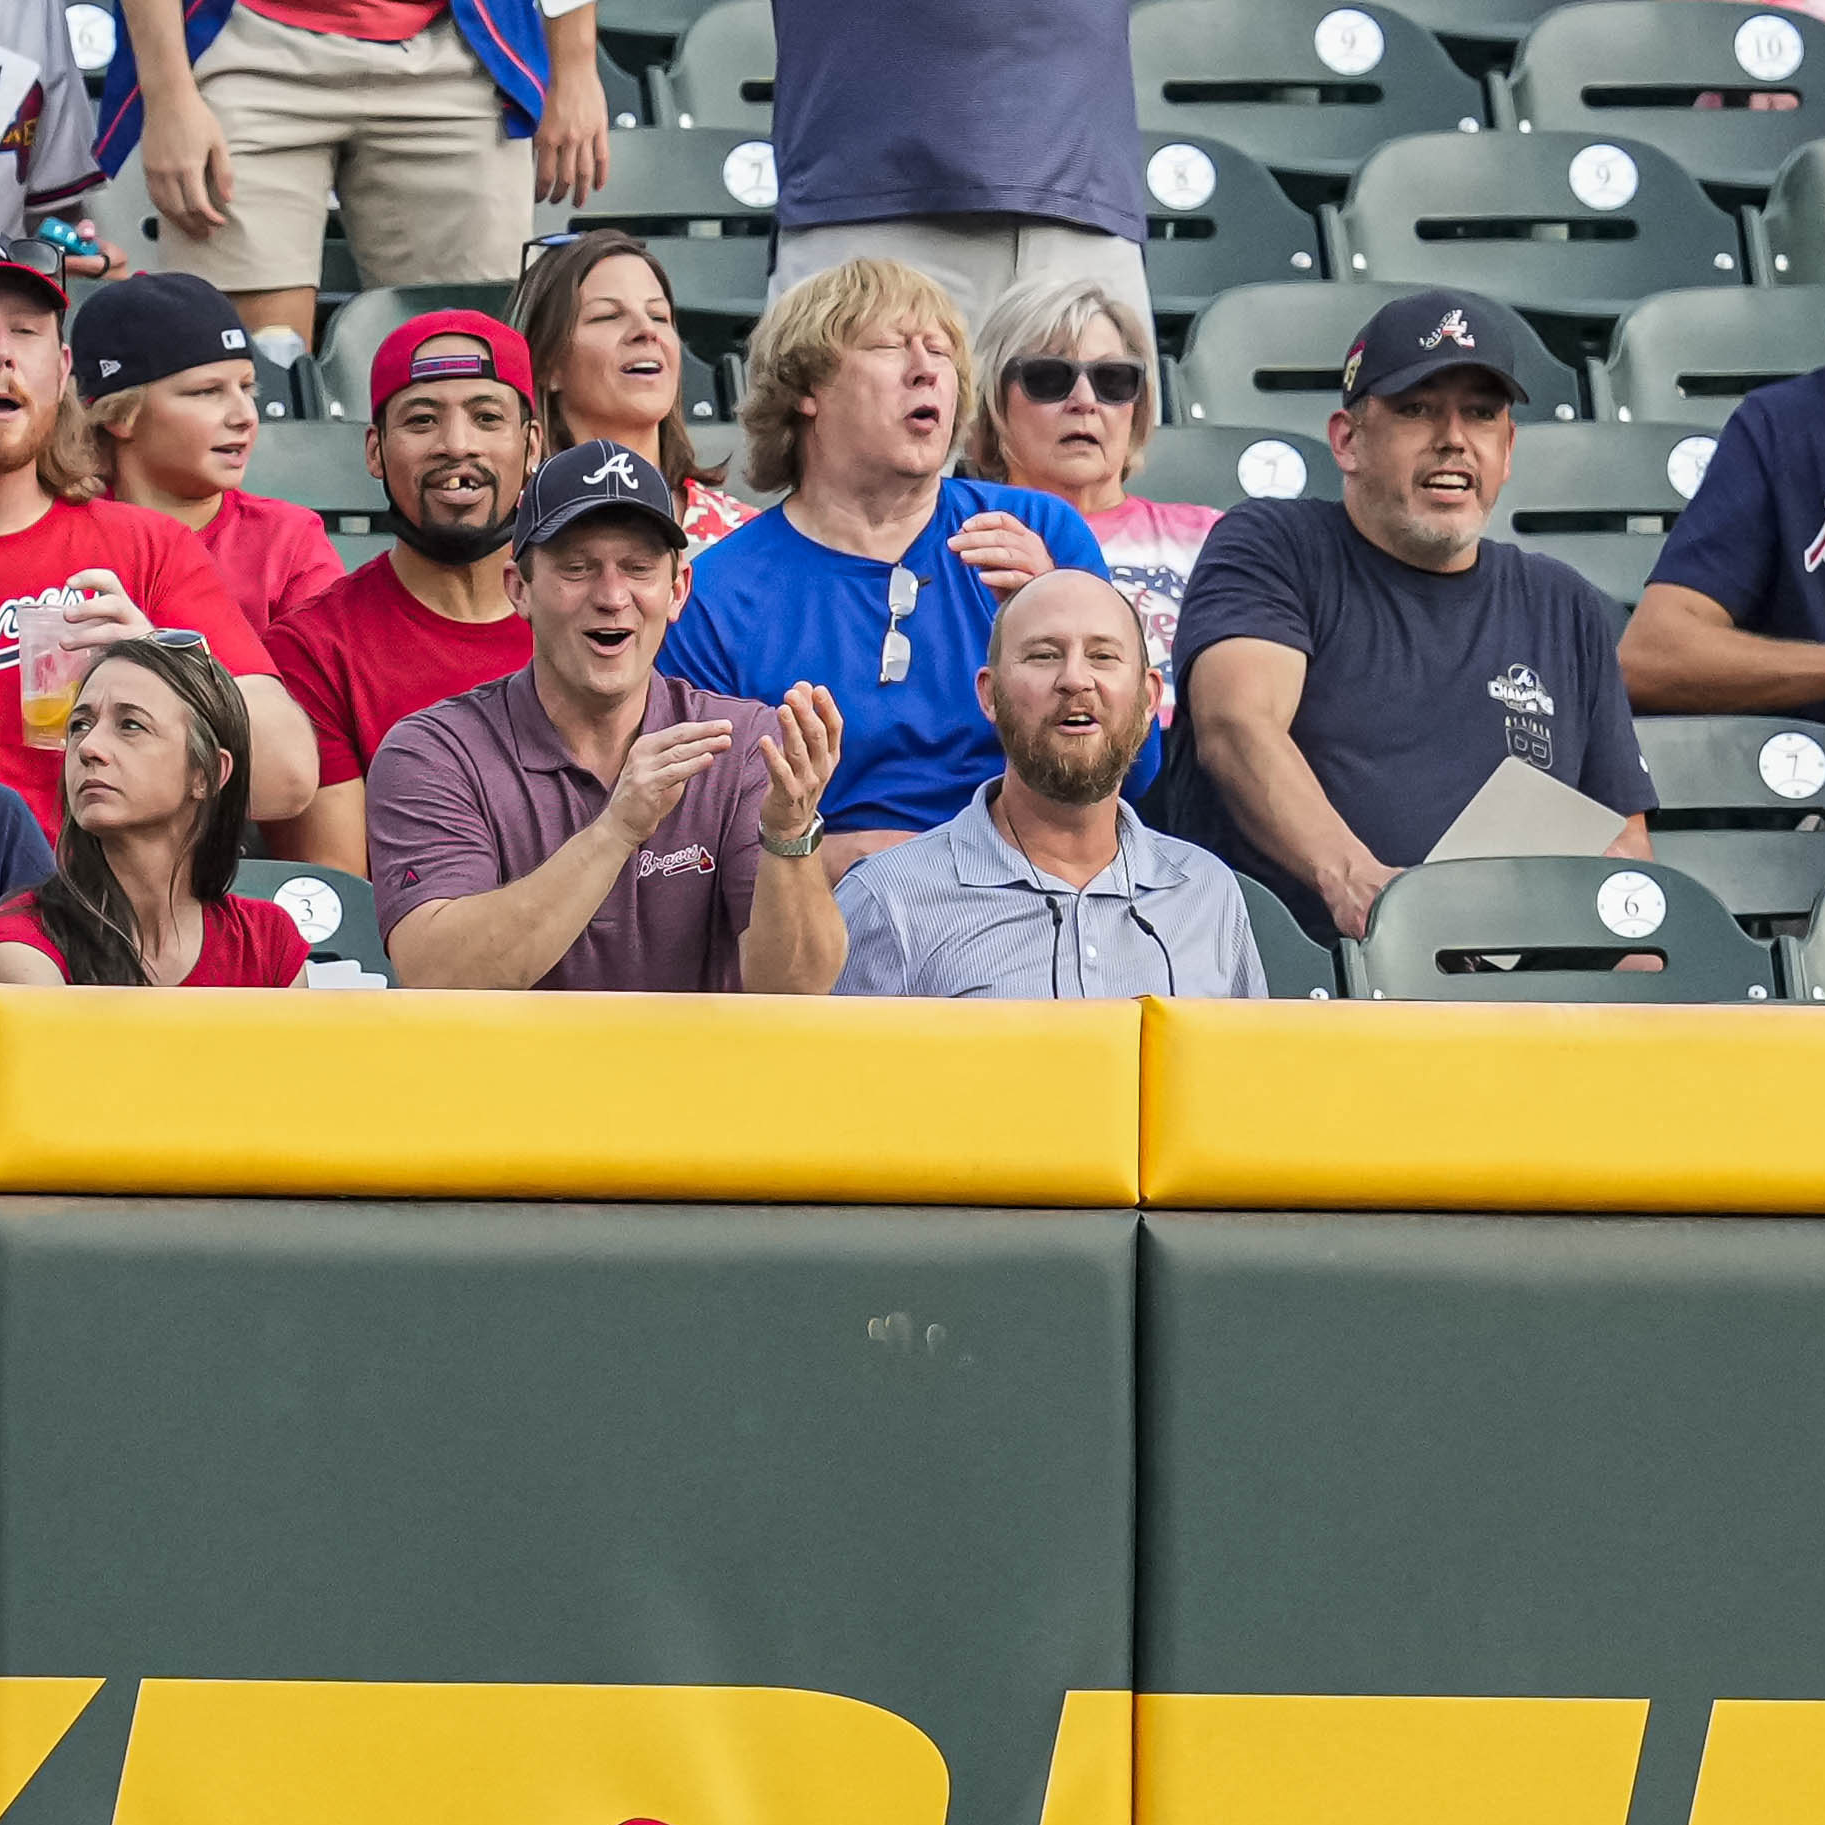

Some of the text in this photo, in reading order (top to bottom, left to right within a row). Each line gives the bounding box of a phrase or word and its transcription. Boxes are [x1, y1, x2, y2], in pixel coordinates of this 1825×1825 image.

[749, 162, 762, 190] 7
[1597, 161, 1611, 187] 9
[583, 452, 639, 490] A
[1263, 459, 1278, 488] 7
[635, 844, 700, 880] Braves
[298, 895, 313, 922] 3
[1624, 894, 1639, 919] 6
